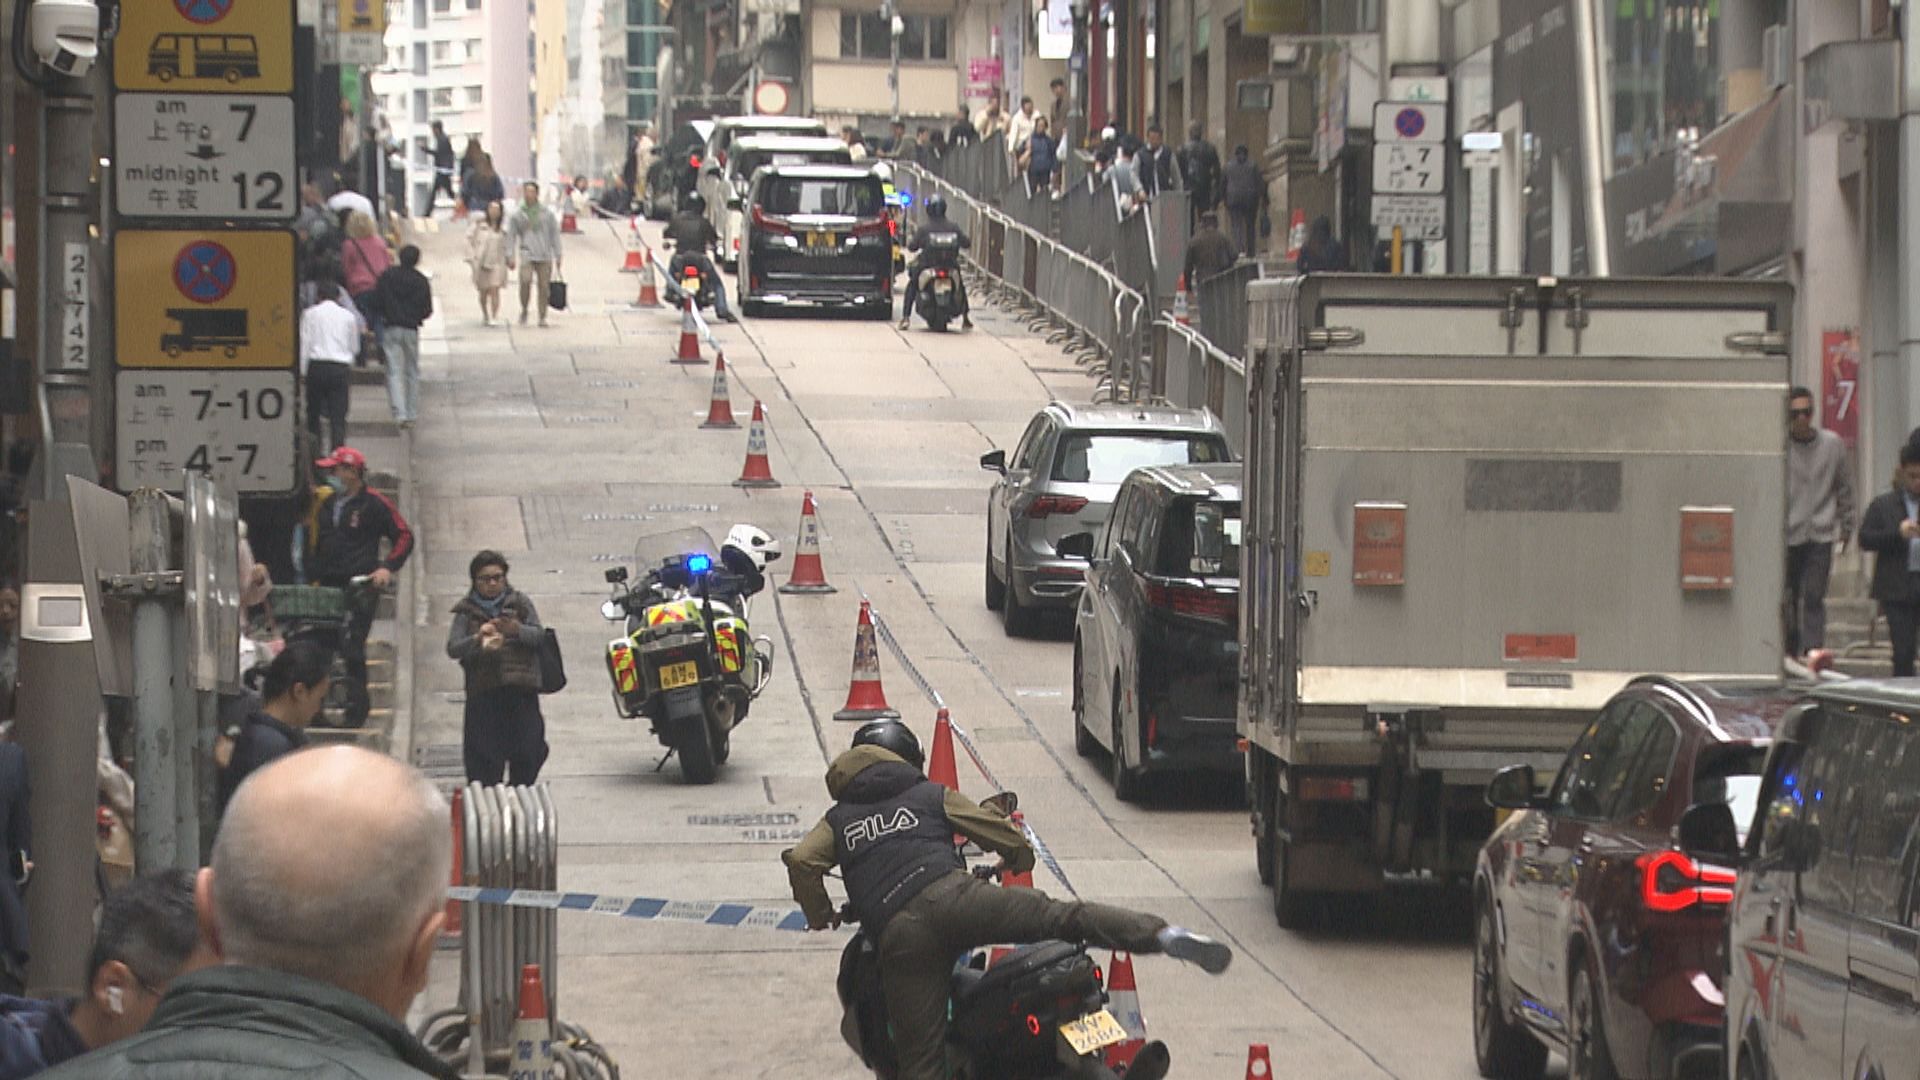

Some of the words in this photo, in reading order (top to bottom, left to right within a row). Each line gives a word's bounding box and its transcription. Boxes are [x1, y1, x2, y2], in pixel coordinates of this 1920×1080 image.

[156, 100, 186, 113] am
[147, 119, 196, 143] 上午
[229, 104, 256, 142] 7
[1418, 148, 1430, 163] 7
[126, 164, 219, 185] midnight
[1417, 172, 1429, 187] 7
[149, 188, 199, 210] 午夜
[233, 171, 283, 209] 12
[69, 254, 85, 363] 21742
[134, 384, 167, 397] am
[190, 387, 284, 421] 7-10
[127, 405, 175, 425] 上午
[134, 439, 168, 456] pm
[127, 460, 175, 479] 下午
[186, 444, 259, 475] 4-7
[844, 807, 919, 851] FILA
